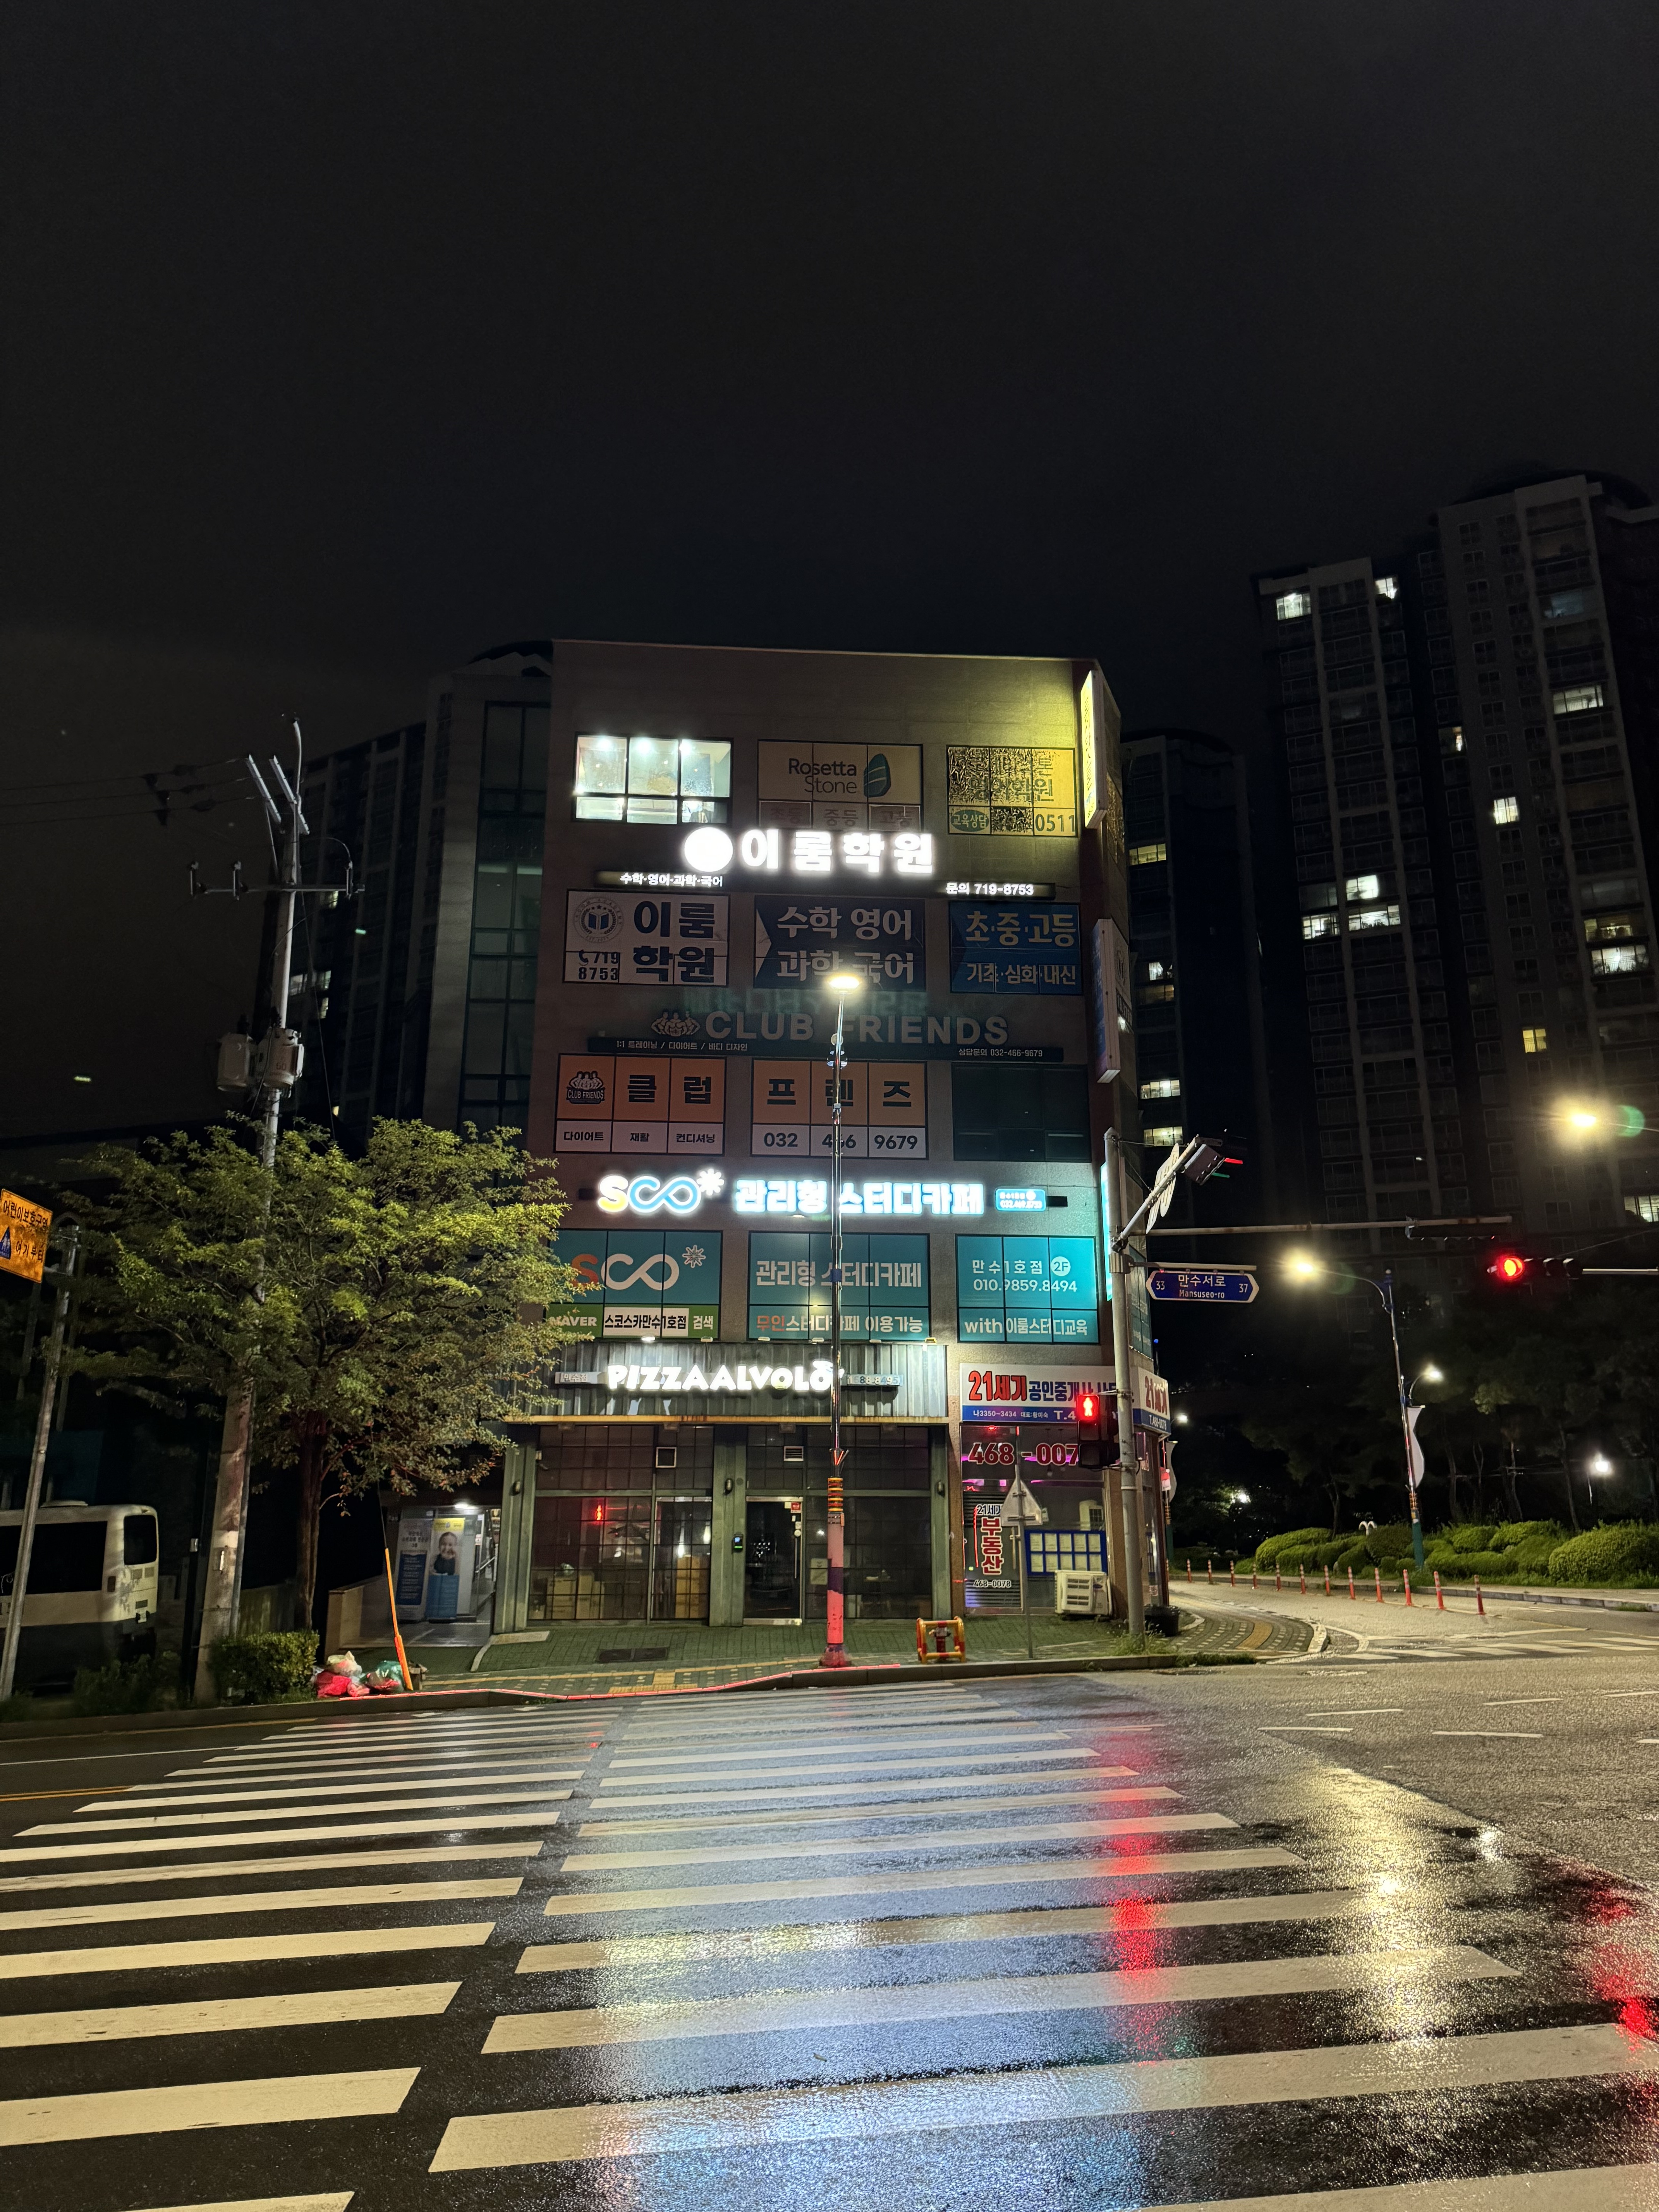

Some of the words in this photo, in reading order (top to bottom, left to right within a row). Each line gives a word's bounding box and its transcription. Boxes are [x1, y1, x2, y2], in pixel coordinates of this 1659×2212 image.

[789, 758, 857, 776] Rosetta
[804, 775, 857, 794] Stone
[952, 814, 988, 828] 교육상담
[1035, 814, 1075, 832] 0511
[742, 828, 933, 874] 이룸학원
[945, 882, 970, 895] 문의
[974, 883, 1034, 896] 719-8753
[634, 900, 715, 939] 이룸
[777, 907, 842, 939] 수학
[851, 908, 912, 940] 영어
[594, 952, 619, 964] 719
[633, 945, 715, 983] 학원
[776, 950, 844, 981] 과학
[852, 952, 914, 984] 국어
[578, 967, 619, 981] 8753
[705, 1011, 813, 1041] CLUB
[835, 1014, 1008, 1045] FRIENDS
[628, 1041, 658, 1049] 트레이닝
[668, 1042, 697, 1050] 다이어트
[708, 1042, 723, 1051] 바디
[726, 1043, 748, 1051] 디자인
[568, 1089, 581, 1098] CLUB
[582, 1090, 604, 1099] FRIENDS
[563, 1131, 604, 1142] 다이어트
[630, 1132, 649, 1143] 재활
[676, 1132, 715, 1144] 컨디셔닝
[764, 1132, 799, 1147] 032
[822, 1134, 856, 1149] 46
[874, 1135, 918, 1150] 9679
[735, 1179, 827, 1213] 관리형
[839, 1182, 984, 1214] 스터디카페
[3, 1200, 49, 1228] 어린이보호구역
[16, 1240, 44, 1264] 여기부터
[756, 1260, 816, 1287] 관리형
[1054, 1261, 1069, 1272] 2F
[973, 1279, 1078, 1293] 010.9859.8494
[1156, 1280, 1165, 1290] 33
[1178, 1274, 1226, 1287] 만수서로
[1239, 1283, 1248, 1293] 37
[1179, 1290, 1225, 1299] Mansuseo-ro
[693, 1315, 714, 1330] 검색
[756, 1314, 860, 1332] 무인스터디페
[865, 1316, 923, 1333] 이용가능
[964, 1318, 1003, 1334] with
[1006, 1317, 1088, 1336] 이룸스터디교육
[968, 1370, 1027, 1401] 21세기
[967, 1442, 1079, 1466] 468-007
[980, 1516, 1005, 1575] 부동산
[973, 1579, 1012, 1588] 468-0078
